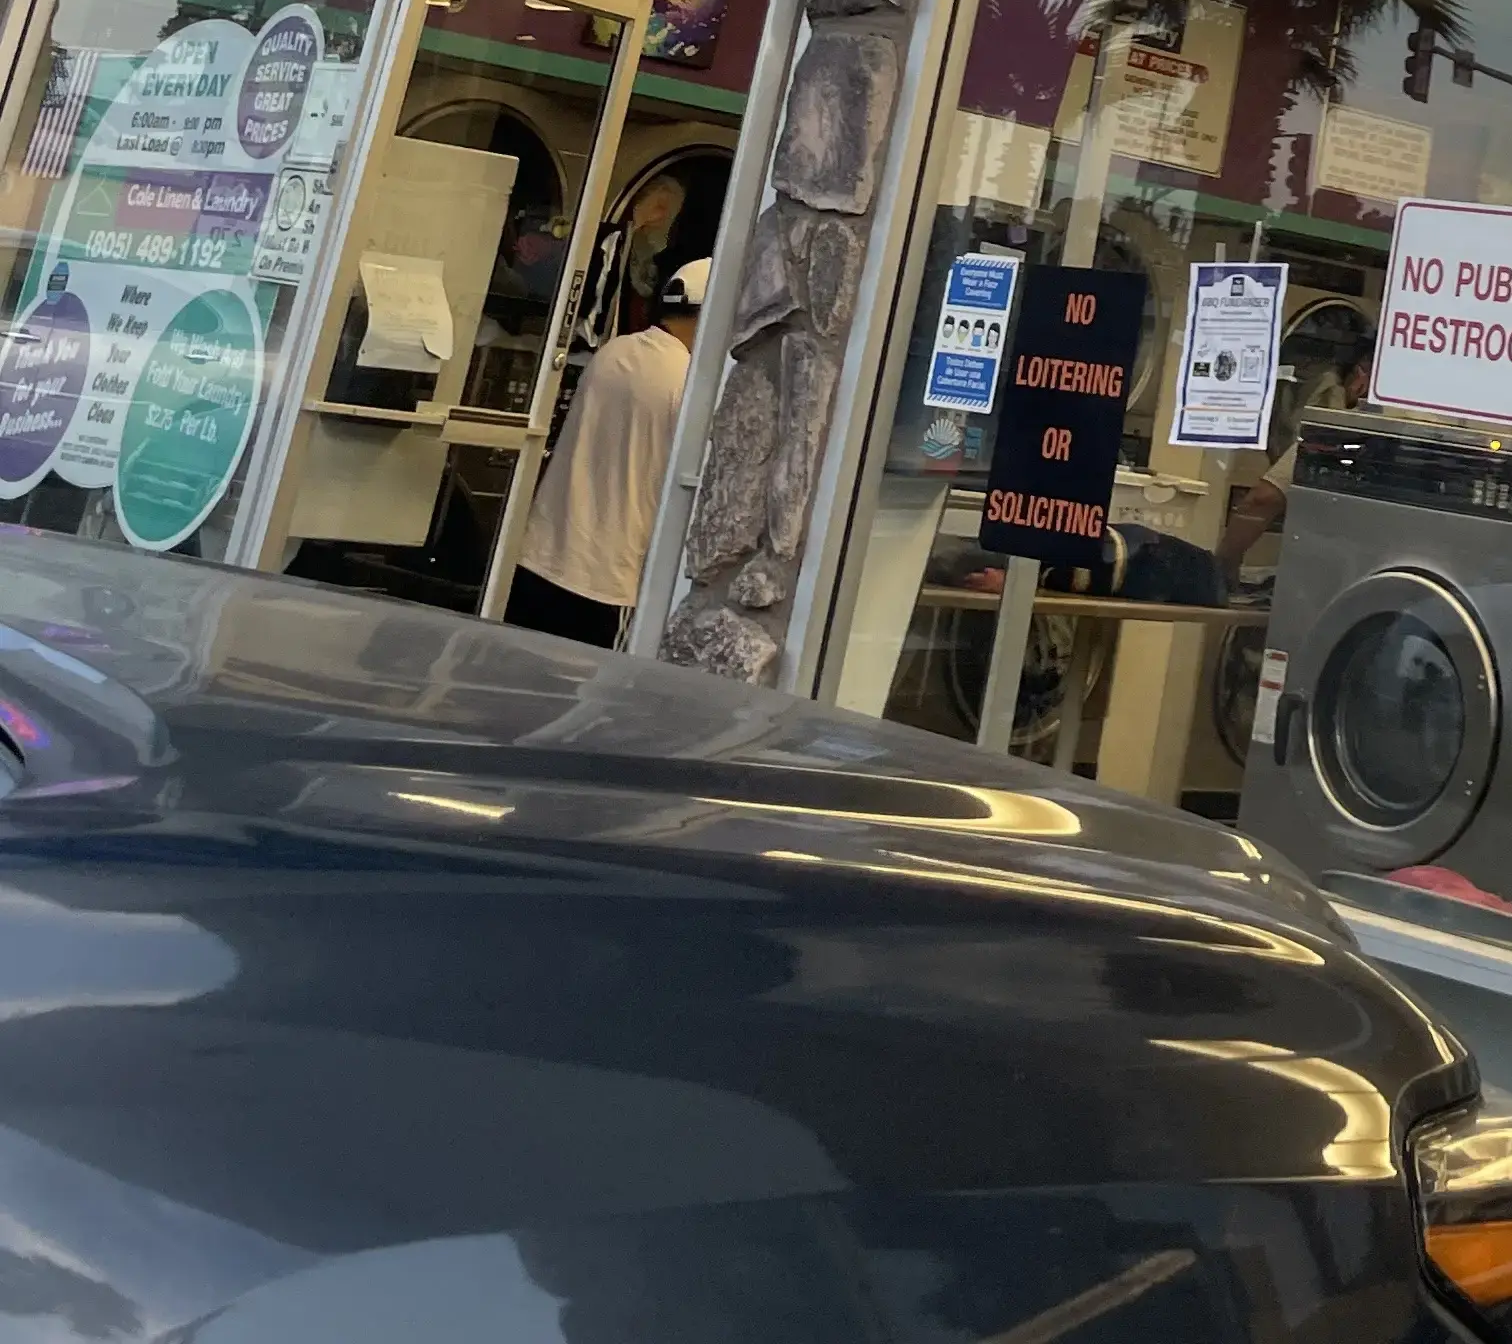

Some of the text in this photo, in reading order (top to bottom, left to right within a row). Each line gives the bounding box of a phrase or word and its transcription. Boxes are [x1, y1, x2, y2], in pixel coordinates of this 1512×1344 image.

[171, 39, 219, 65] OPEN
[261, 30, 314, 57] QUALITY
[141, 72, 232, 98] EVERYDAY
[254, 60, 307, 84] SERVICE
[253, 91, 295, 113] GREAT
[116, 134, 140, 151] Last
[141, 134, 170, 152] Load
[243, 116, 289, 144] PRICES
[127, 183, 260, 220] Cole Linen & Laundry
[1402, 256, 1445, 295] NO
[120, 283, 152, 307] Where
[106, 312, 123, 332] We
[1064, 292, 1096, 326] NO
[91, 371, 130, 396] Clothes
[1015, 354, 1124, 398] LOITERING
[199, 377, 248, 416] Laundry
[1041, 426, 1073, 462] OR
[987, 488, 1104, 539] SOLICITING
